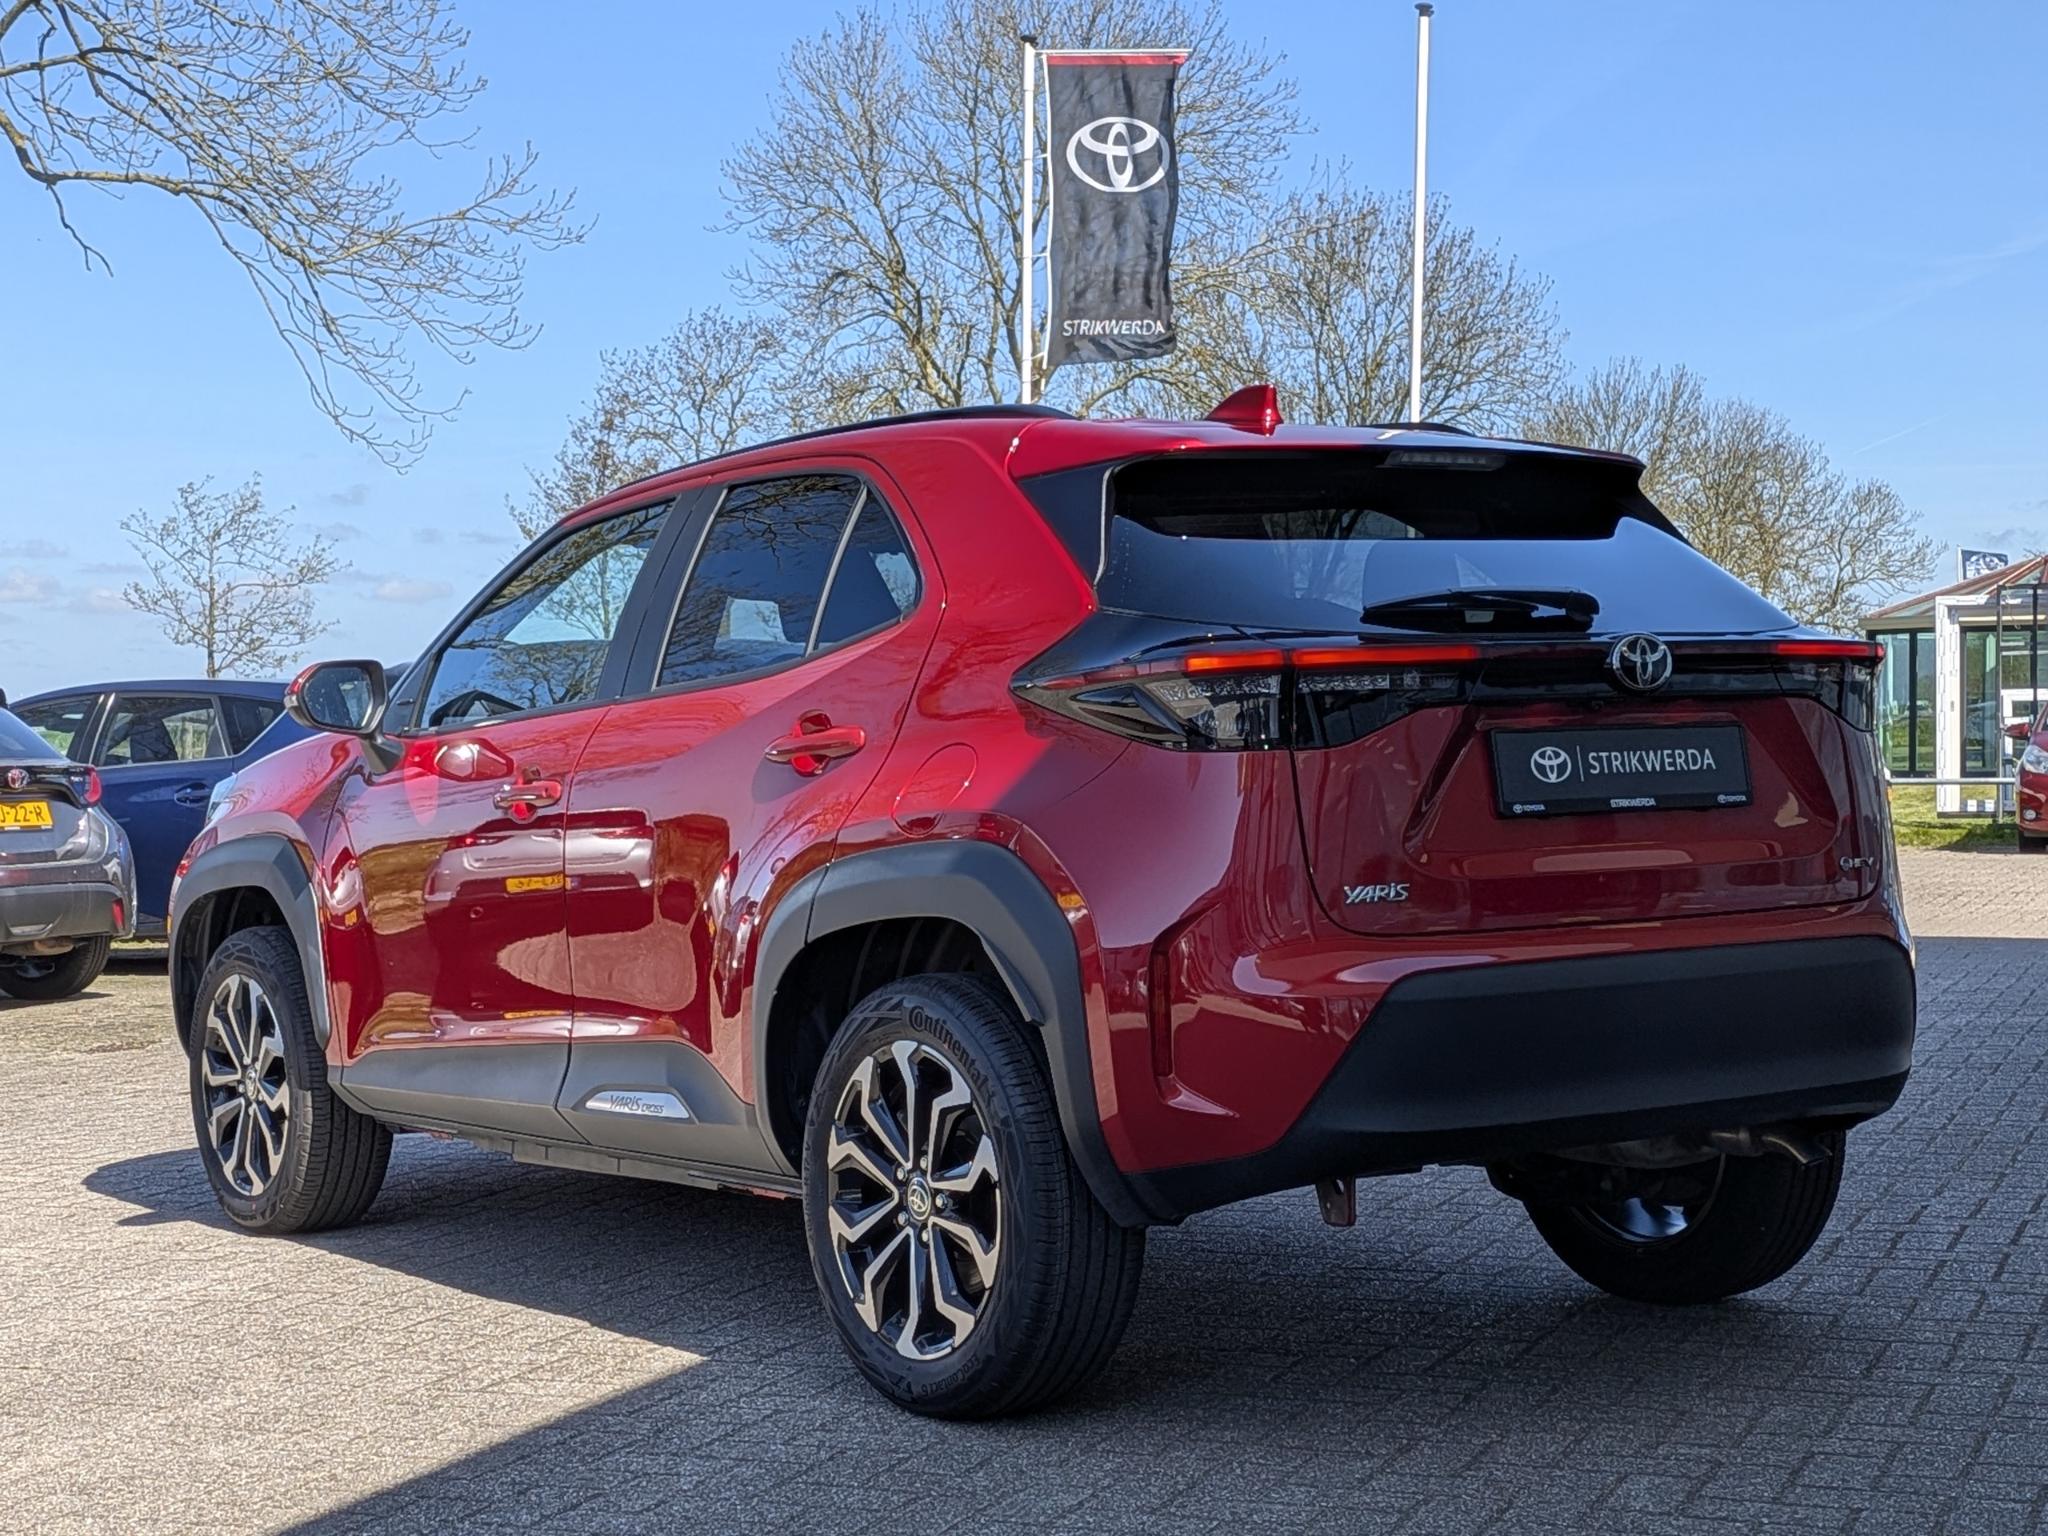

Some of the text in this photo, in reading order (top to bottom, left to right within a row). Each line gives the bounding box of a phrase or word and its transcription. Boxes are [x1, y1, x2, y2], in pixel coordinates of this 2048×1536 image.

[1062, 319, 1166, 336] STRIKWERDA
[1588, 749, 1716, 774] STRIKWERDA
[1610, 798, 1656, 808] STRIKWERDA
[909, 1006, 989, 1091] Continental
